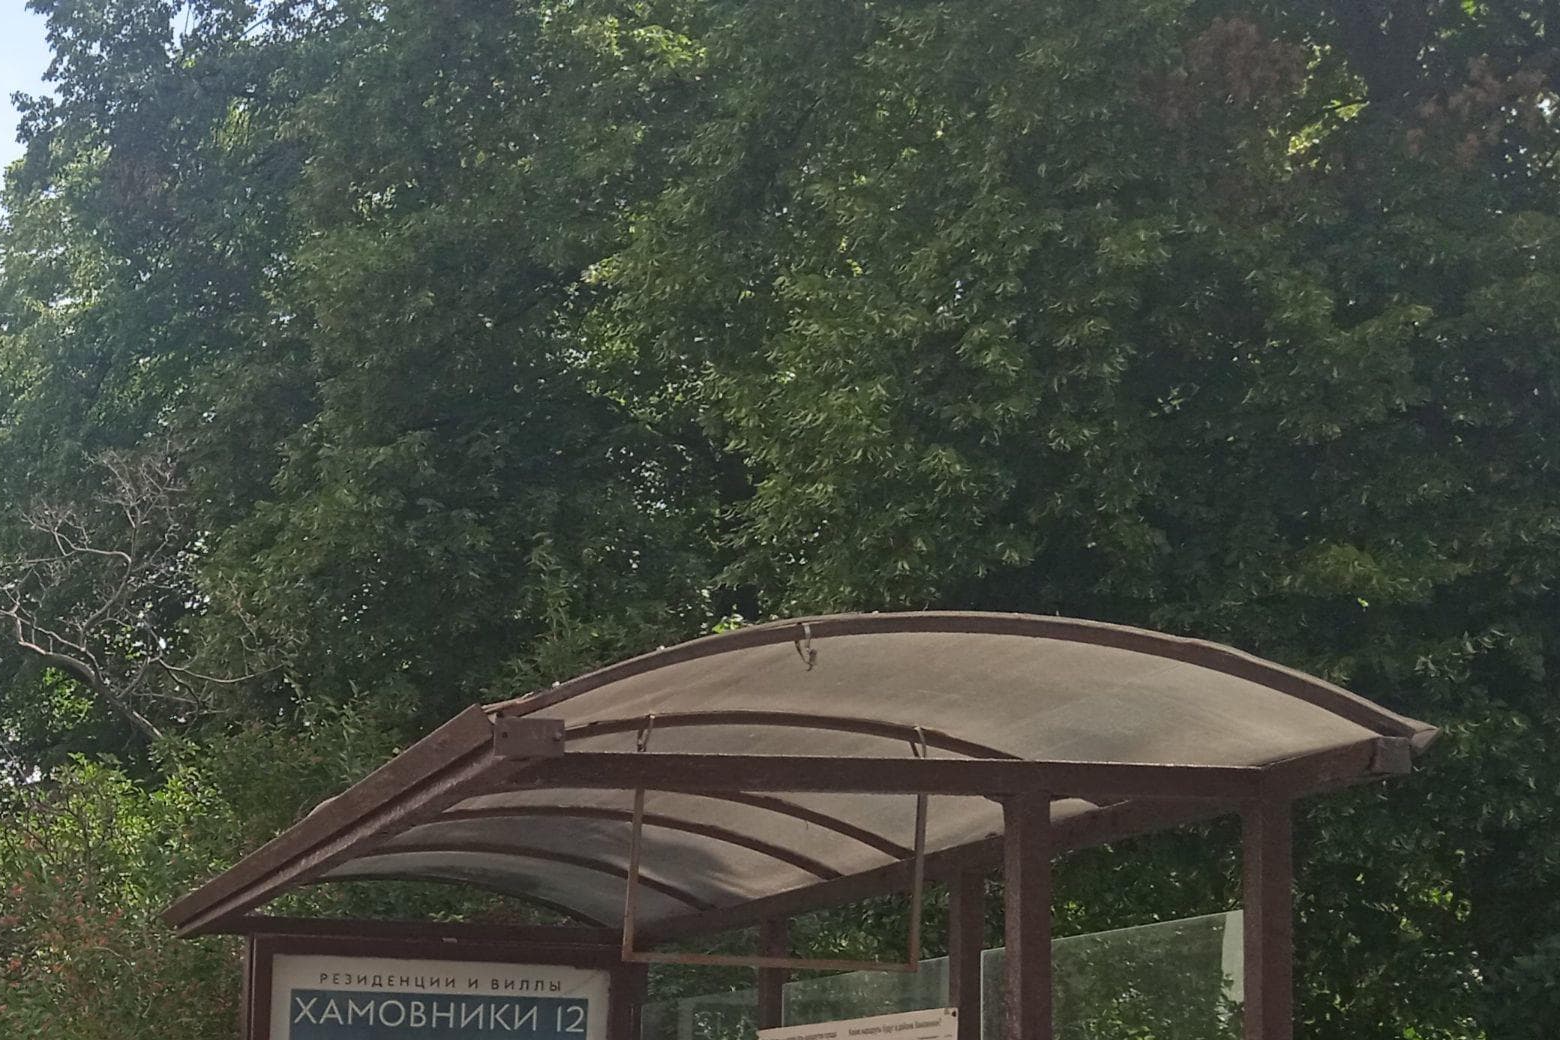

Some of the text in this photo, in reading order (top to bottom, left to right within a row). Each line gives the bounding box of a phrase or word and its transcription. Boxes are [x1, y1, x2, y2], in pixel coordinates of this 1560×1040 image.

[320, 972, 561, 992] РЕЗИДЕНЦИИ И ВИЛЛЫ
[294, 997, 585, 1032] ХАМОВНИКИ 12
